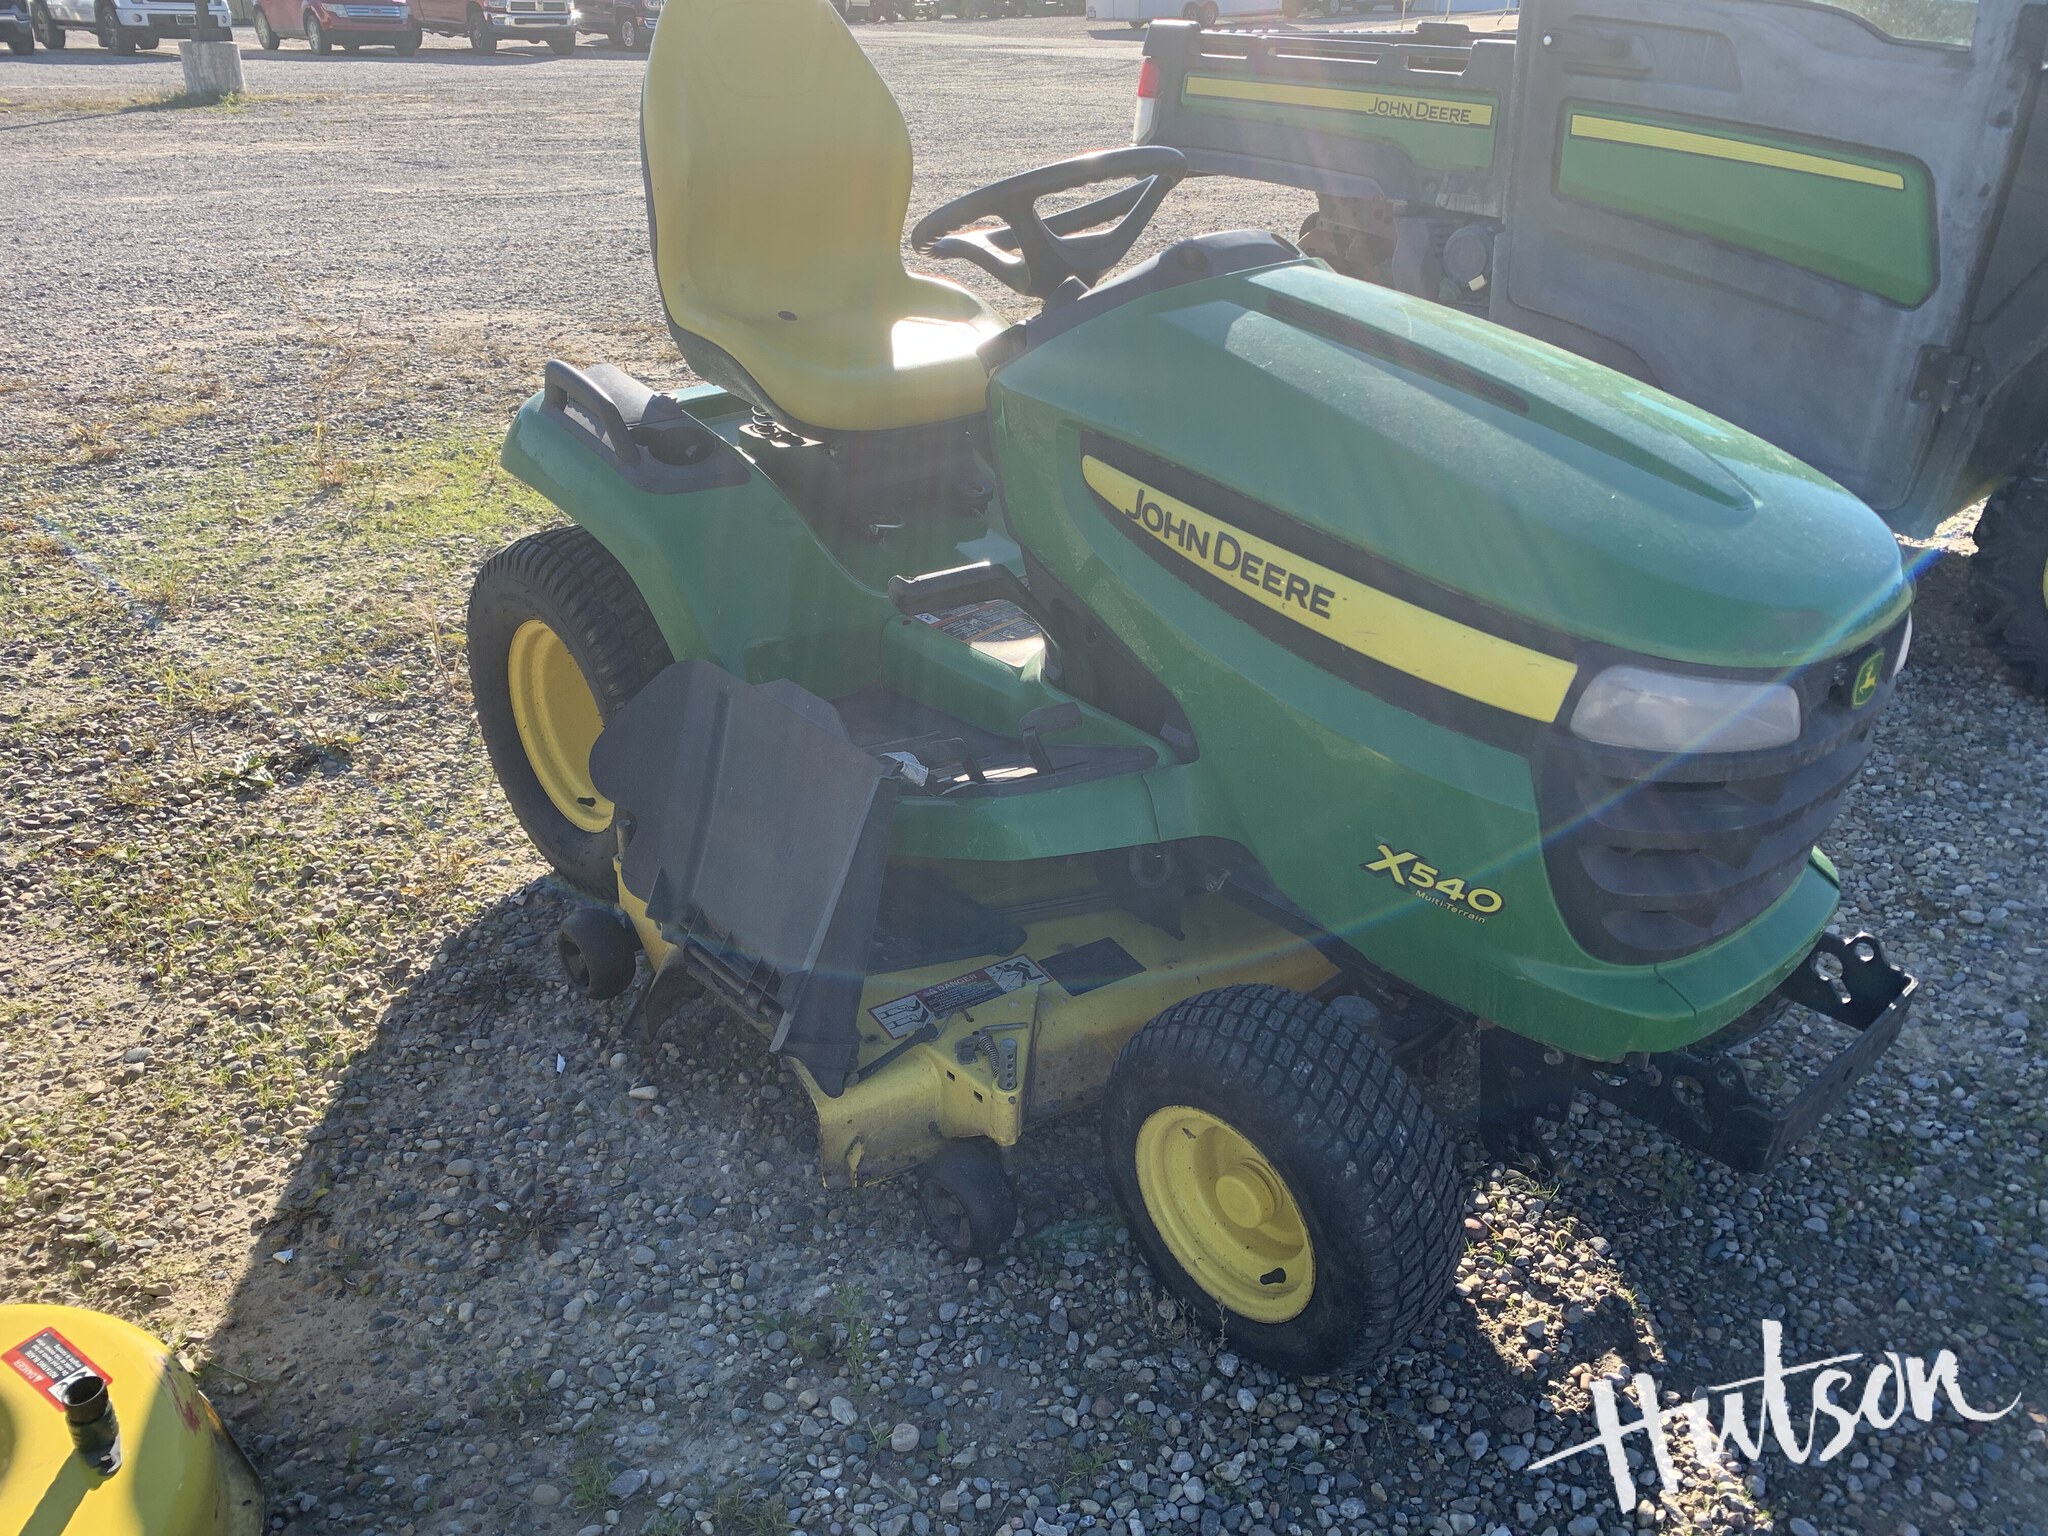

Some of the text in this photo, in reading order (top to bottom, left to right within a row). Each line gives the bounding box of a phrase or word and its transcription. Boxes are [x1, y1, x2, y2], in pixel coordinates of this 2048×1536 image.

[1368, 97, 1471, 123] JOHN DEERE
[1125, 489, 1335, 620] JOHN DEERE
[1364, 844, 1503, 913] X540
[1415, 890, 1486, 924] Multi-Terrain
[937, 974, 977, 992] DANGER
[13, 1359, 36, 1379] DANGER
